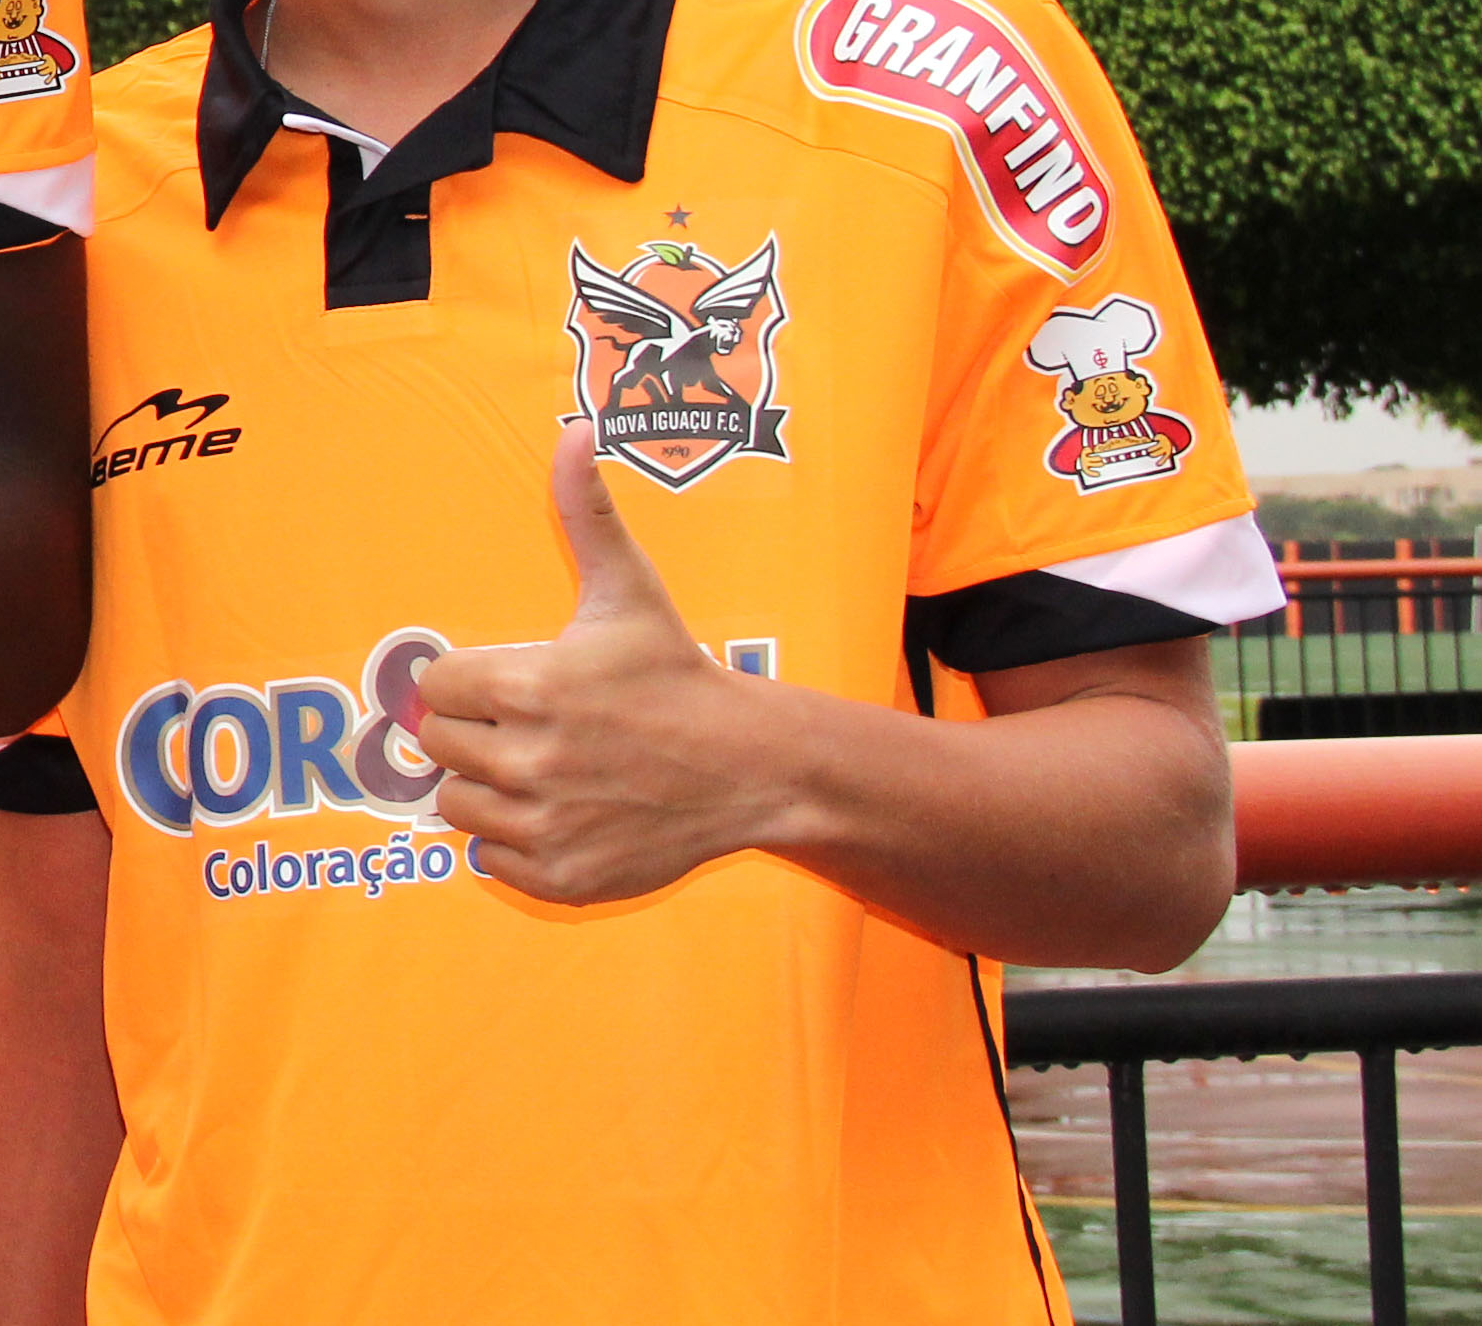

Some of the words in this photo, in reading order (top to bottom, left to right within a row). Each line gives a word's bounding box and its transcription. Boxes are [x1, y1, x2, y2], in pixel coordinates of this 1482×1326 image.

[604, 413, 648, 437] NOVA
[651, 410, 711, 434] IGUAÇU
[204, 834, 453, 899] Coloração
